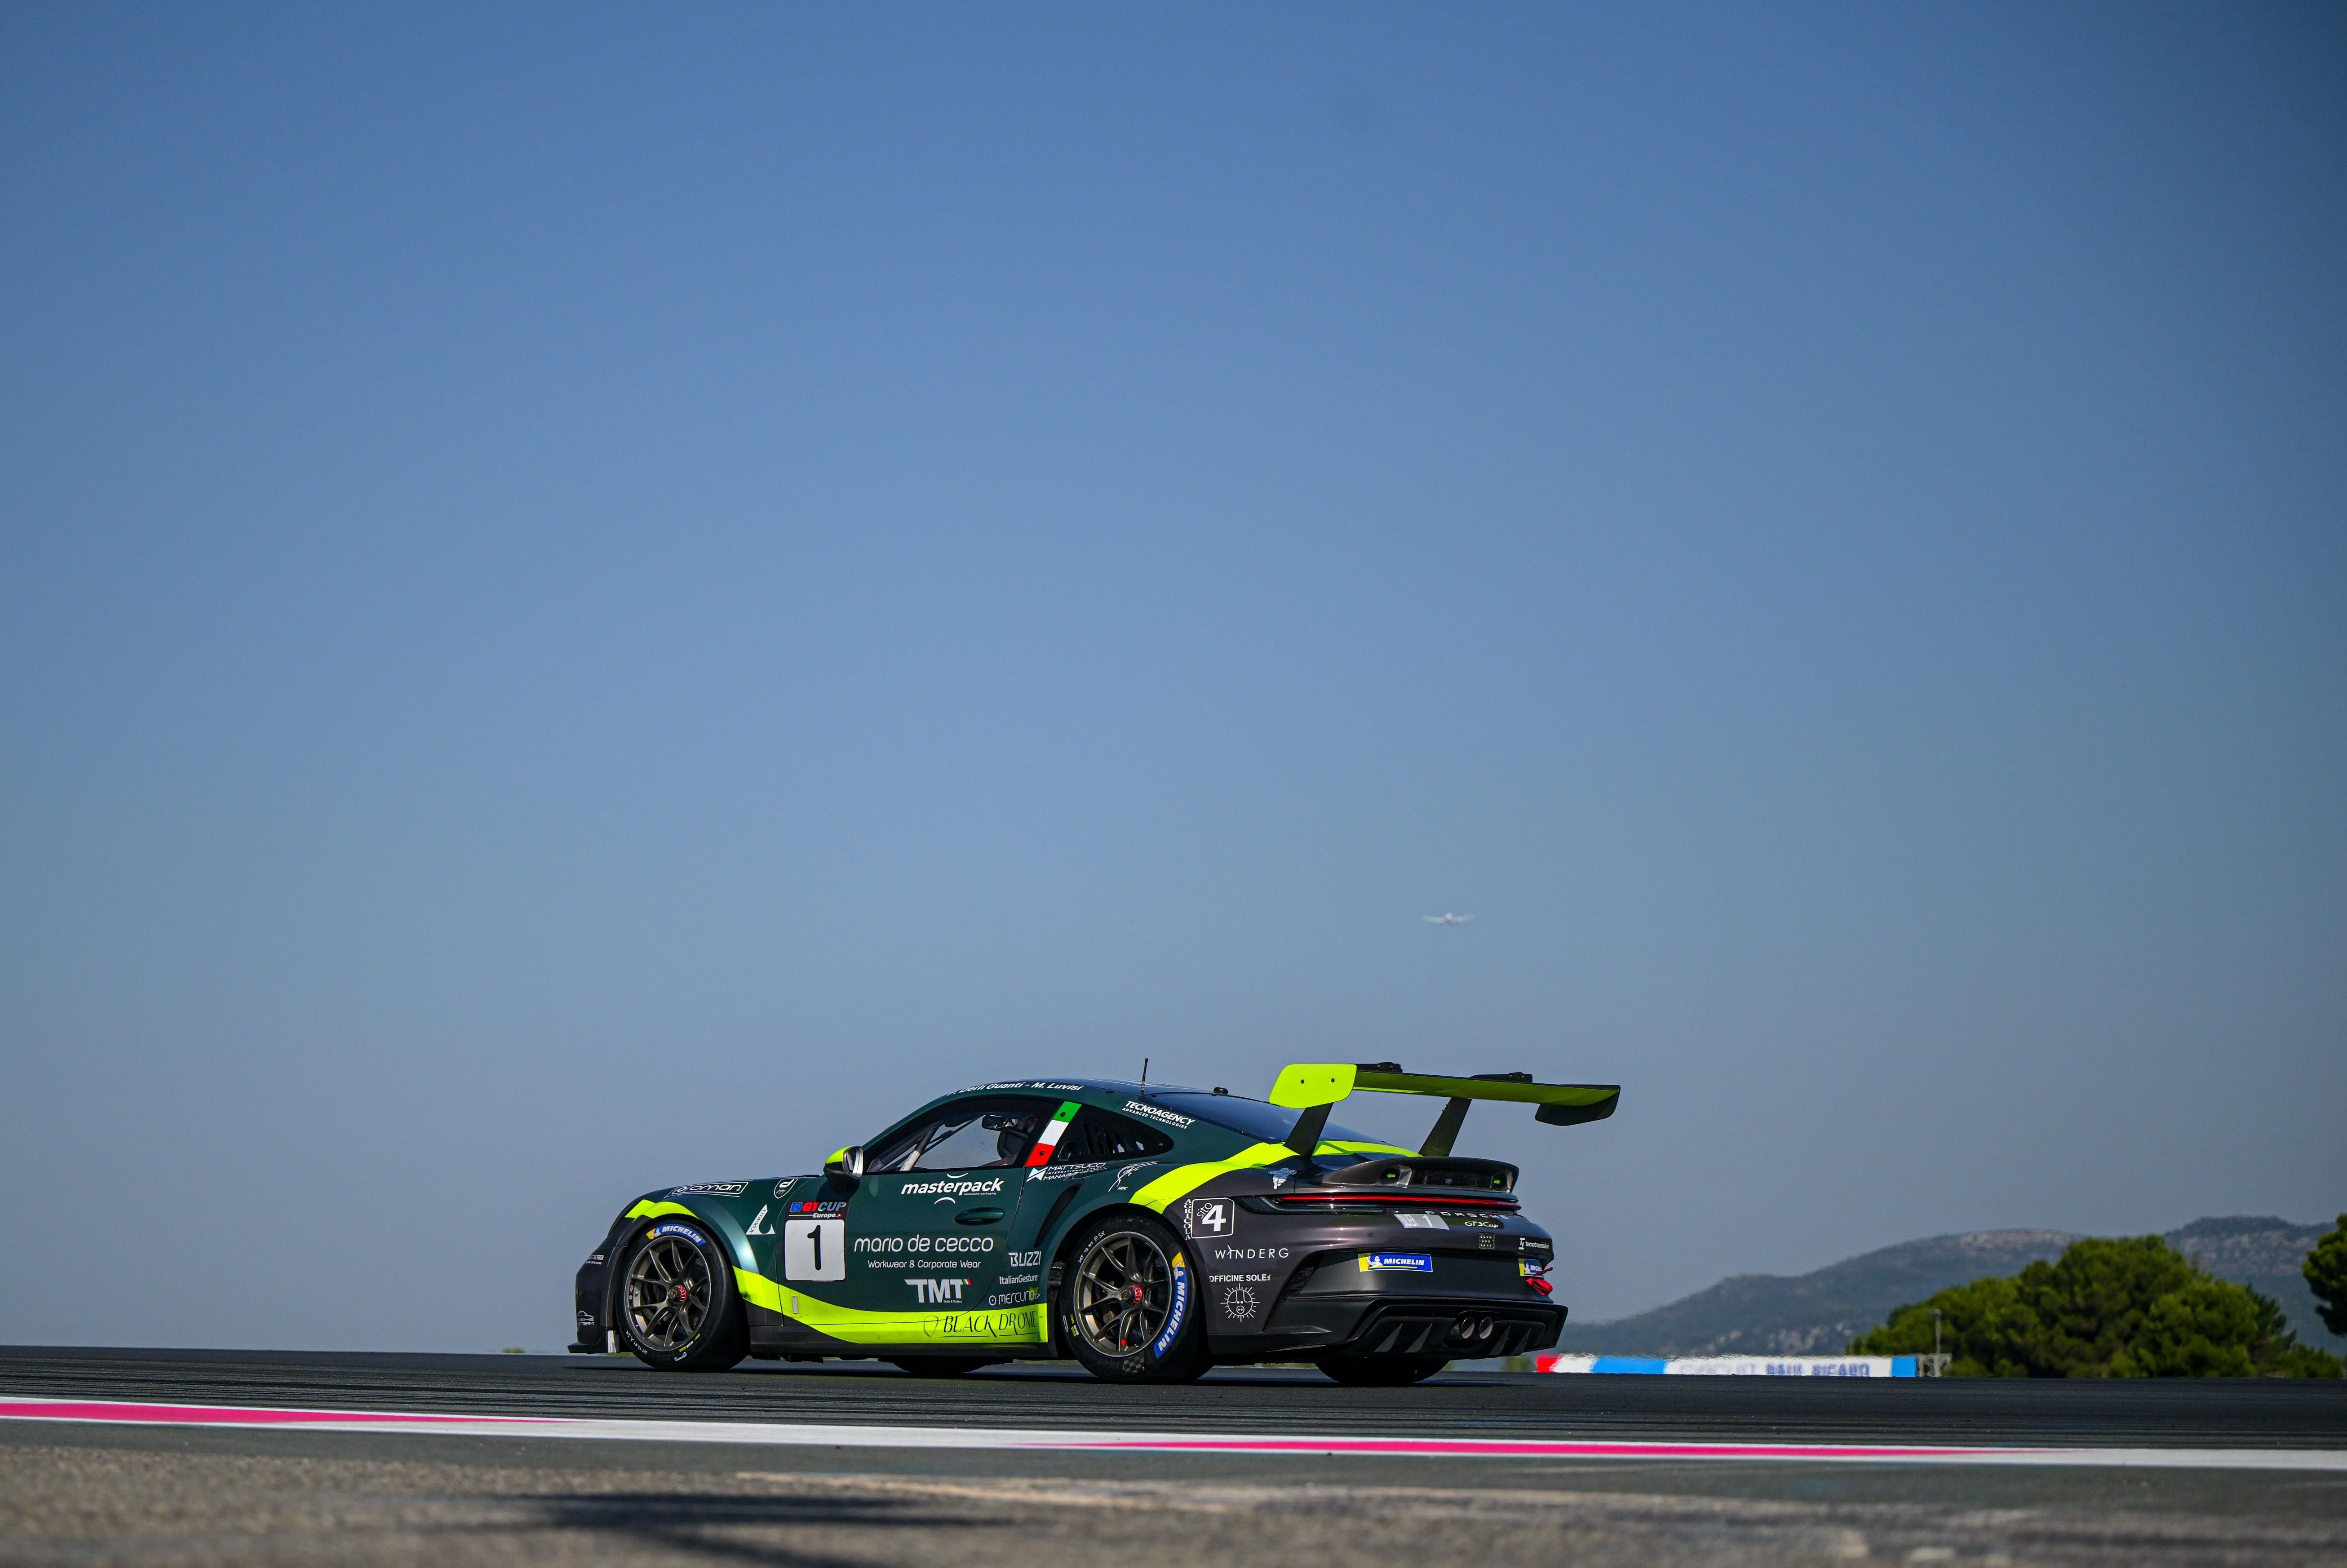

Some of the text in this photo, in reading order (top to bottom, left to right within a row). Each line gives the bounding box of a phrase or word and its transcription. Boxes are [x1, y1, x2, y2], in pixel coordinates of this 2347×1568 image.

[1047, 1082, 1085, 1091] Luvisi
[1122, 1107, 1188, 1129] ADVANCED TECHNOLOGIES
[1125, 1101, 1196, 1125] TECNOAGENCY
[1048, 1162, 1107, 1171] MATTEUCCI
[901, 1178, 1005, 1196] masterpack
[1196, 1202, 1213, 1219] sito
[1202, 1205, 1227, 1232] 4
[1424, 1211, 1509, 1219] PORSCHE
[749, 1209, 767, 1234] ACQUAFLEX
[1183, 1199, 1192, 1241] AGRICOLA
[1422, 1214, 1432, 1227] 1
[661, 1225, 702, 1243] MICHELIN
[854, 1234, 994, 1252] mario de cecco
[807, 1225, 821, 1271] 1
[1215, 1245, 1289, 1259] WINDERG
[868, 1260, 981, 1270] Workwear & Corporate Wear
[1008, 1251, 1041, 1267] BUZZI
[999, 1274, 1038, 1285] ItalianGesture
[1209, 1275, 1244, 1283] OFFICINE
[904, 1279, 965, 1303] TMT
[943, 1314, 997, 1338] BLACK
[998, 1310, 1039, 1335] DROME
[1158, 1281, 1185, 1352] MICHELIN
